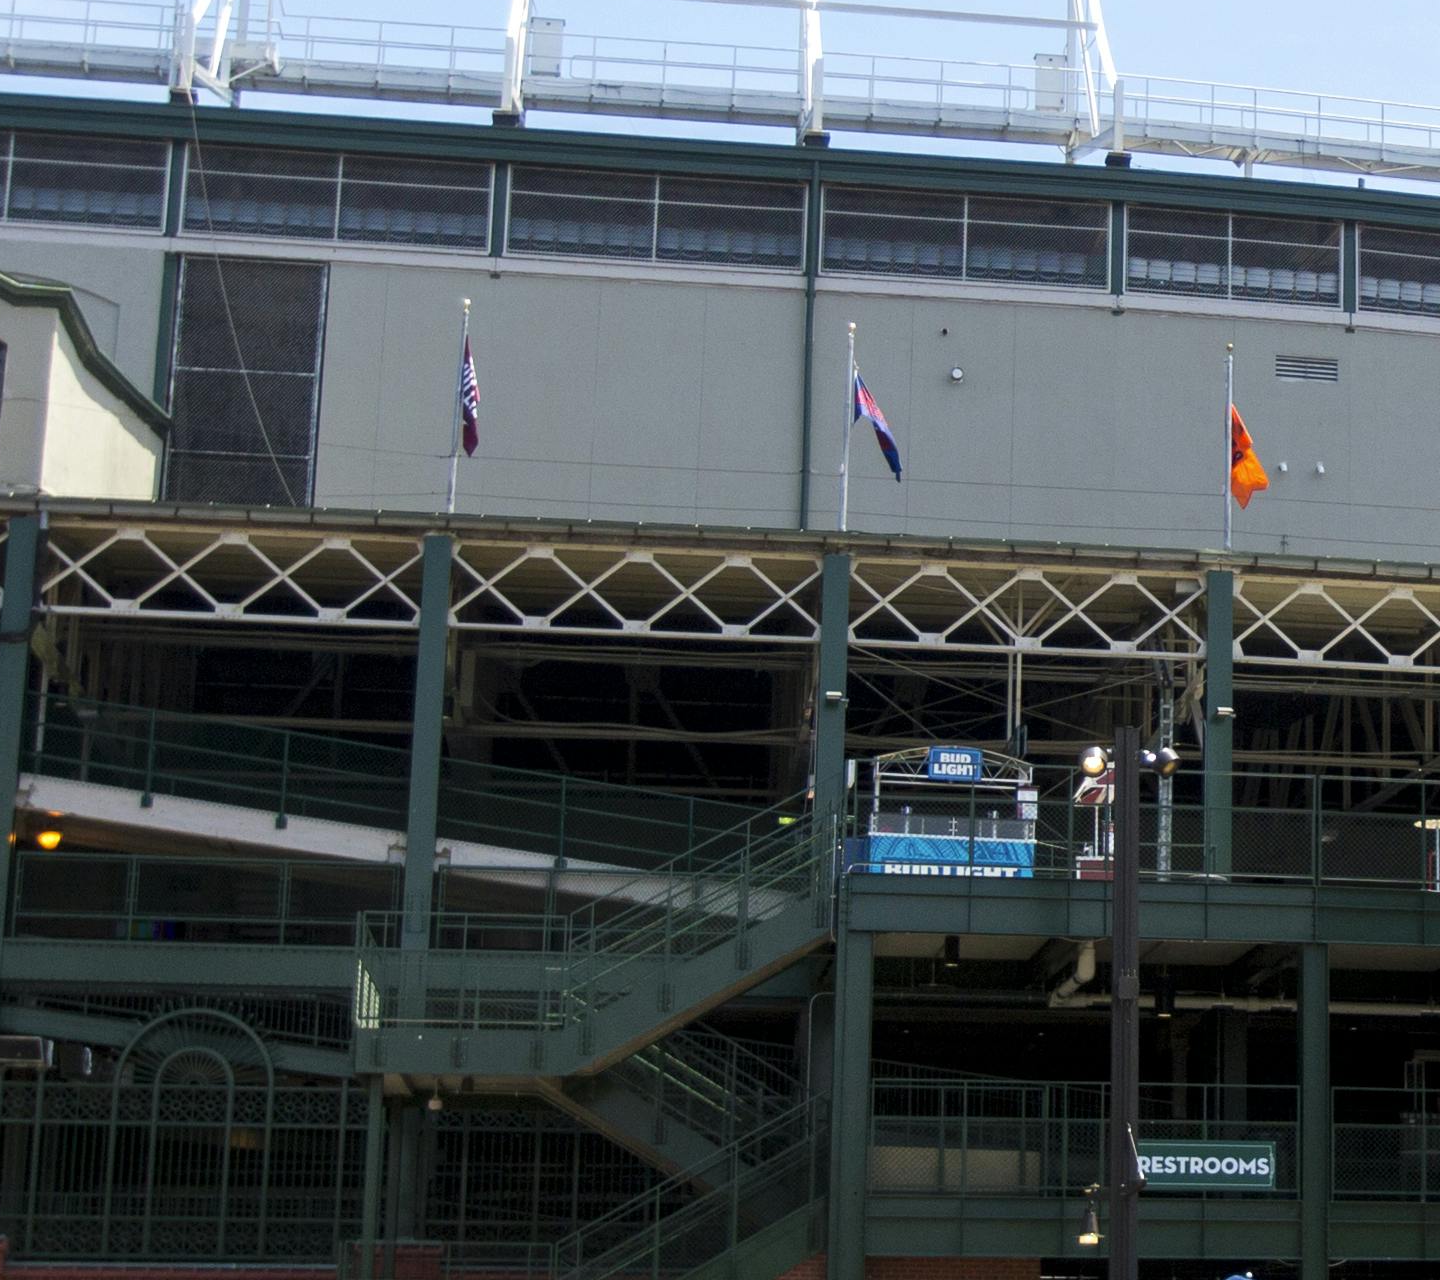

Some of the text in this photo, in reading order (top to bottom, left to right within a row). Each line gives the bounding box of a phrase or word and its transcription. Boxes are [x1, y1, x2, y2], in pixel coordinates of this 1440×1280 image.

[940, 753, 972, 763] BUD
[933, 764, 977, 776] LIGHT
[1138, 1156, 1270, 1176] RESTROOMS
